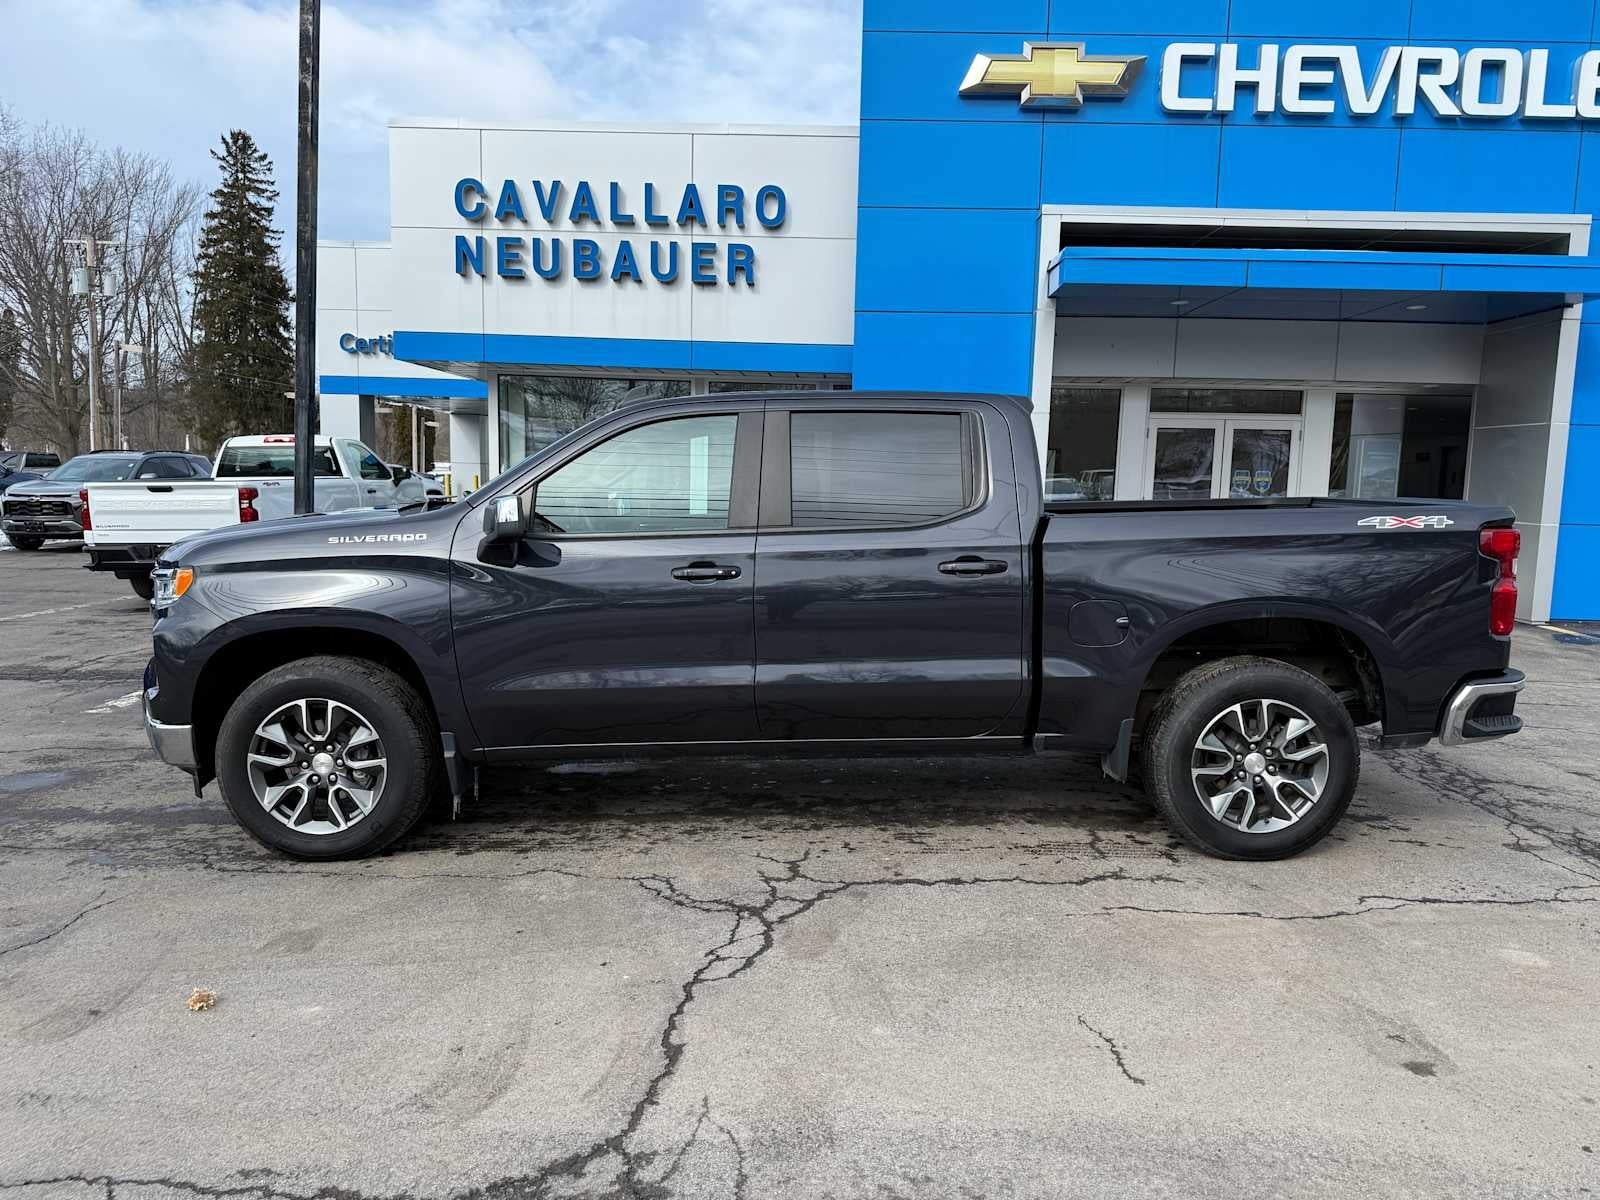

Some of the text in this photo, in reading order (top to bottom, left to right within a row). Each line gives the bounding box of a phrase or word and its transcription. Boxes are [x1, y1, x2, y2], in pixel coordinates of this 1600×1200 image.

[454, 178, 787, 230] CAVALLARO
[455, 235, 756, 287] NEUBAUER
[327, 533, 428, 544] SILVERADO
